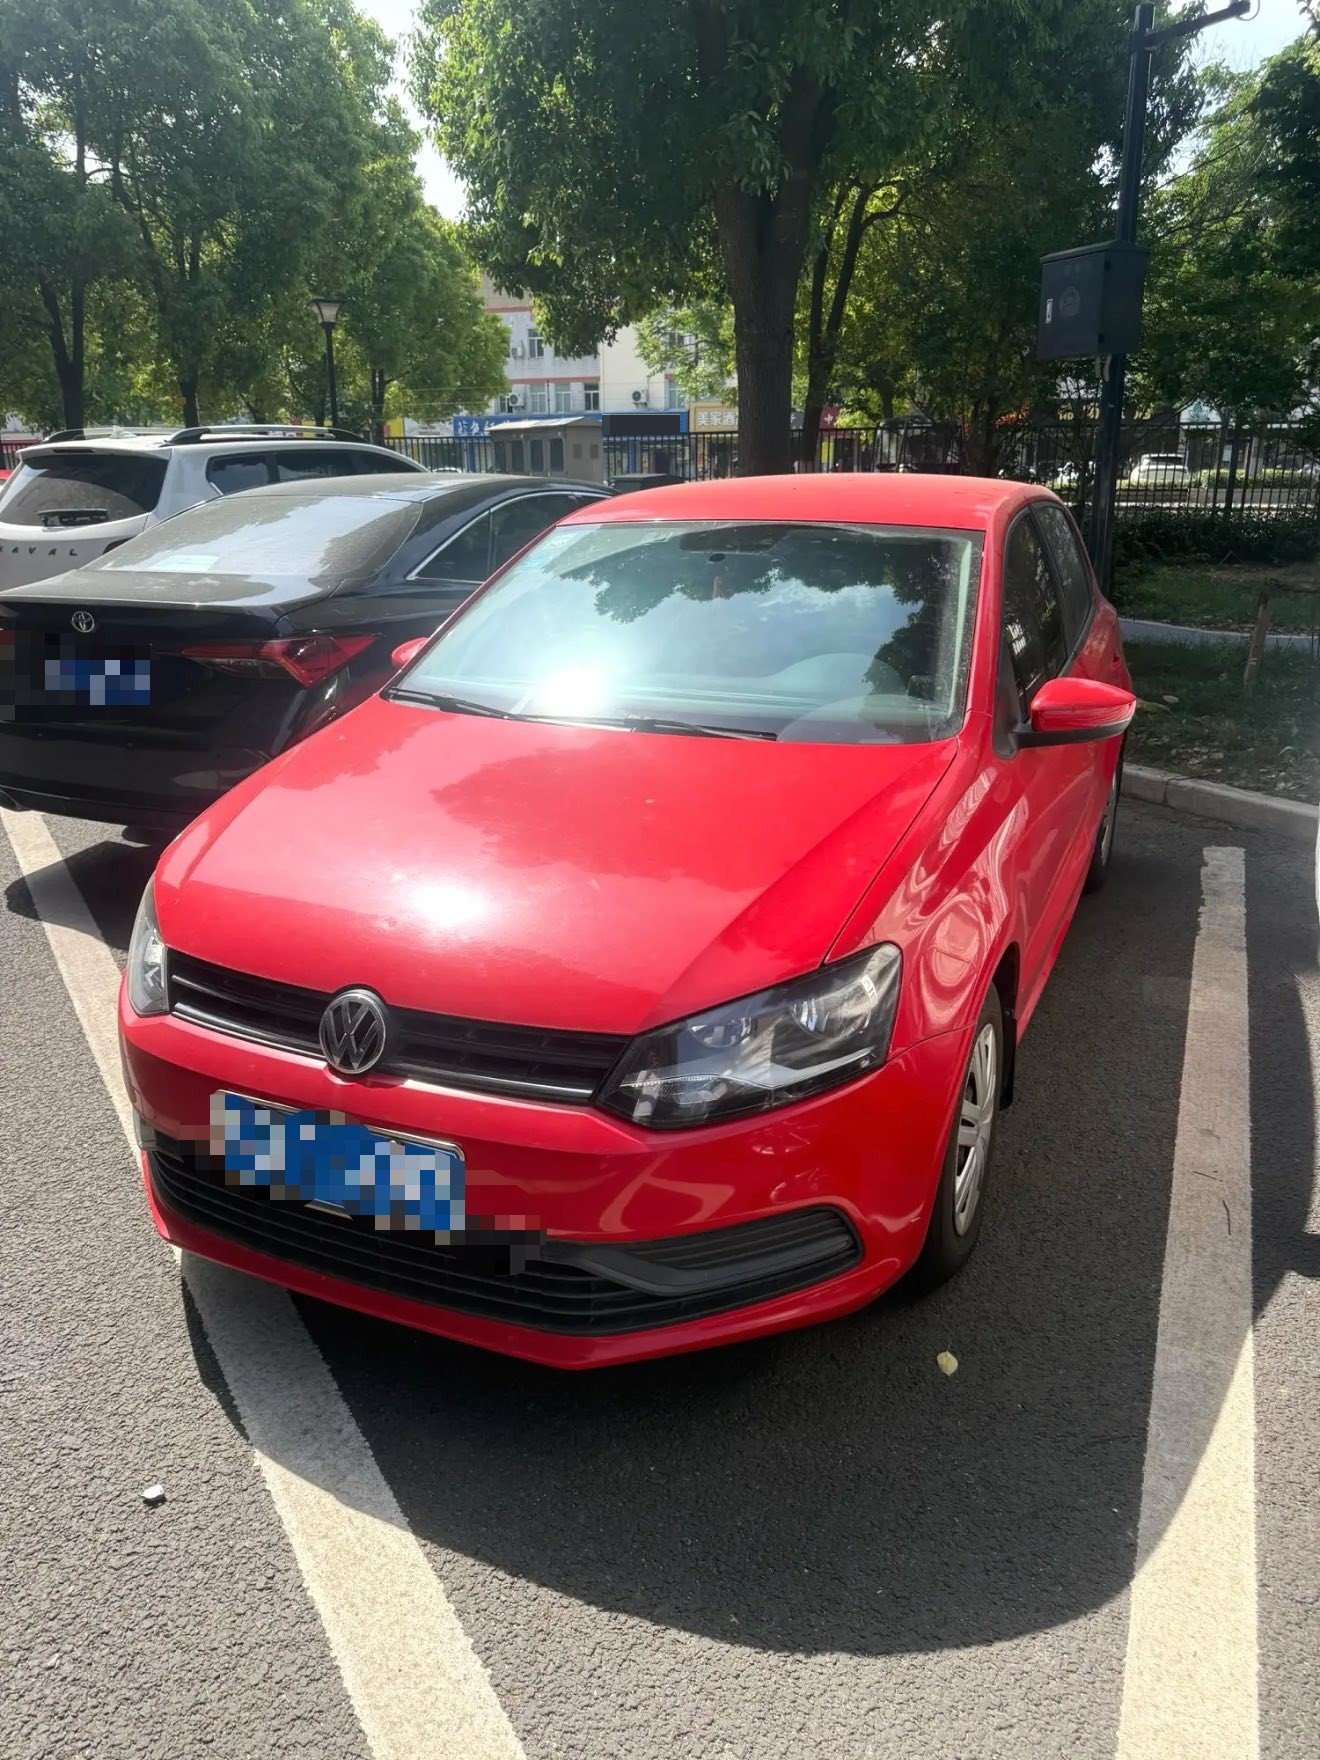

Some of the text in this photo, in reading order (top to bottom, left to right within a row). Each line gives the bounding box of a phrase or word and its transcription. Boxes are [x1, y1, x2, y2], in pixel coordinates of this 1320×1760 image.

[697, 411, 739, 426] 美家酒
[0, 546, 78, 557] AVAL
